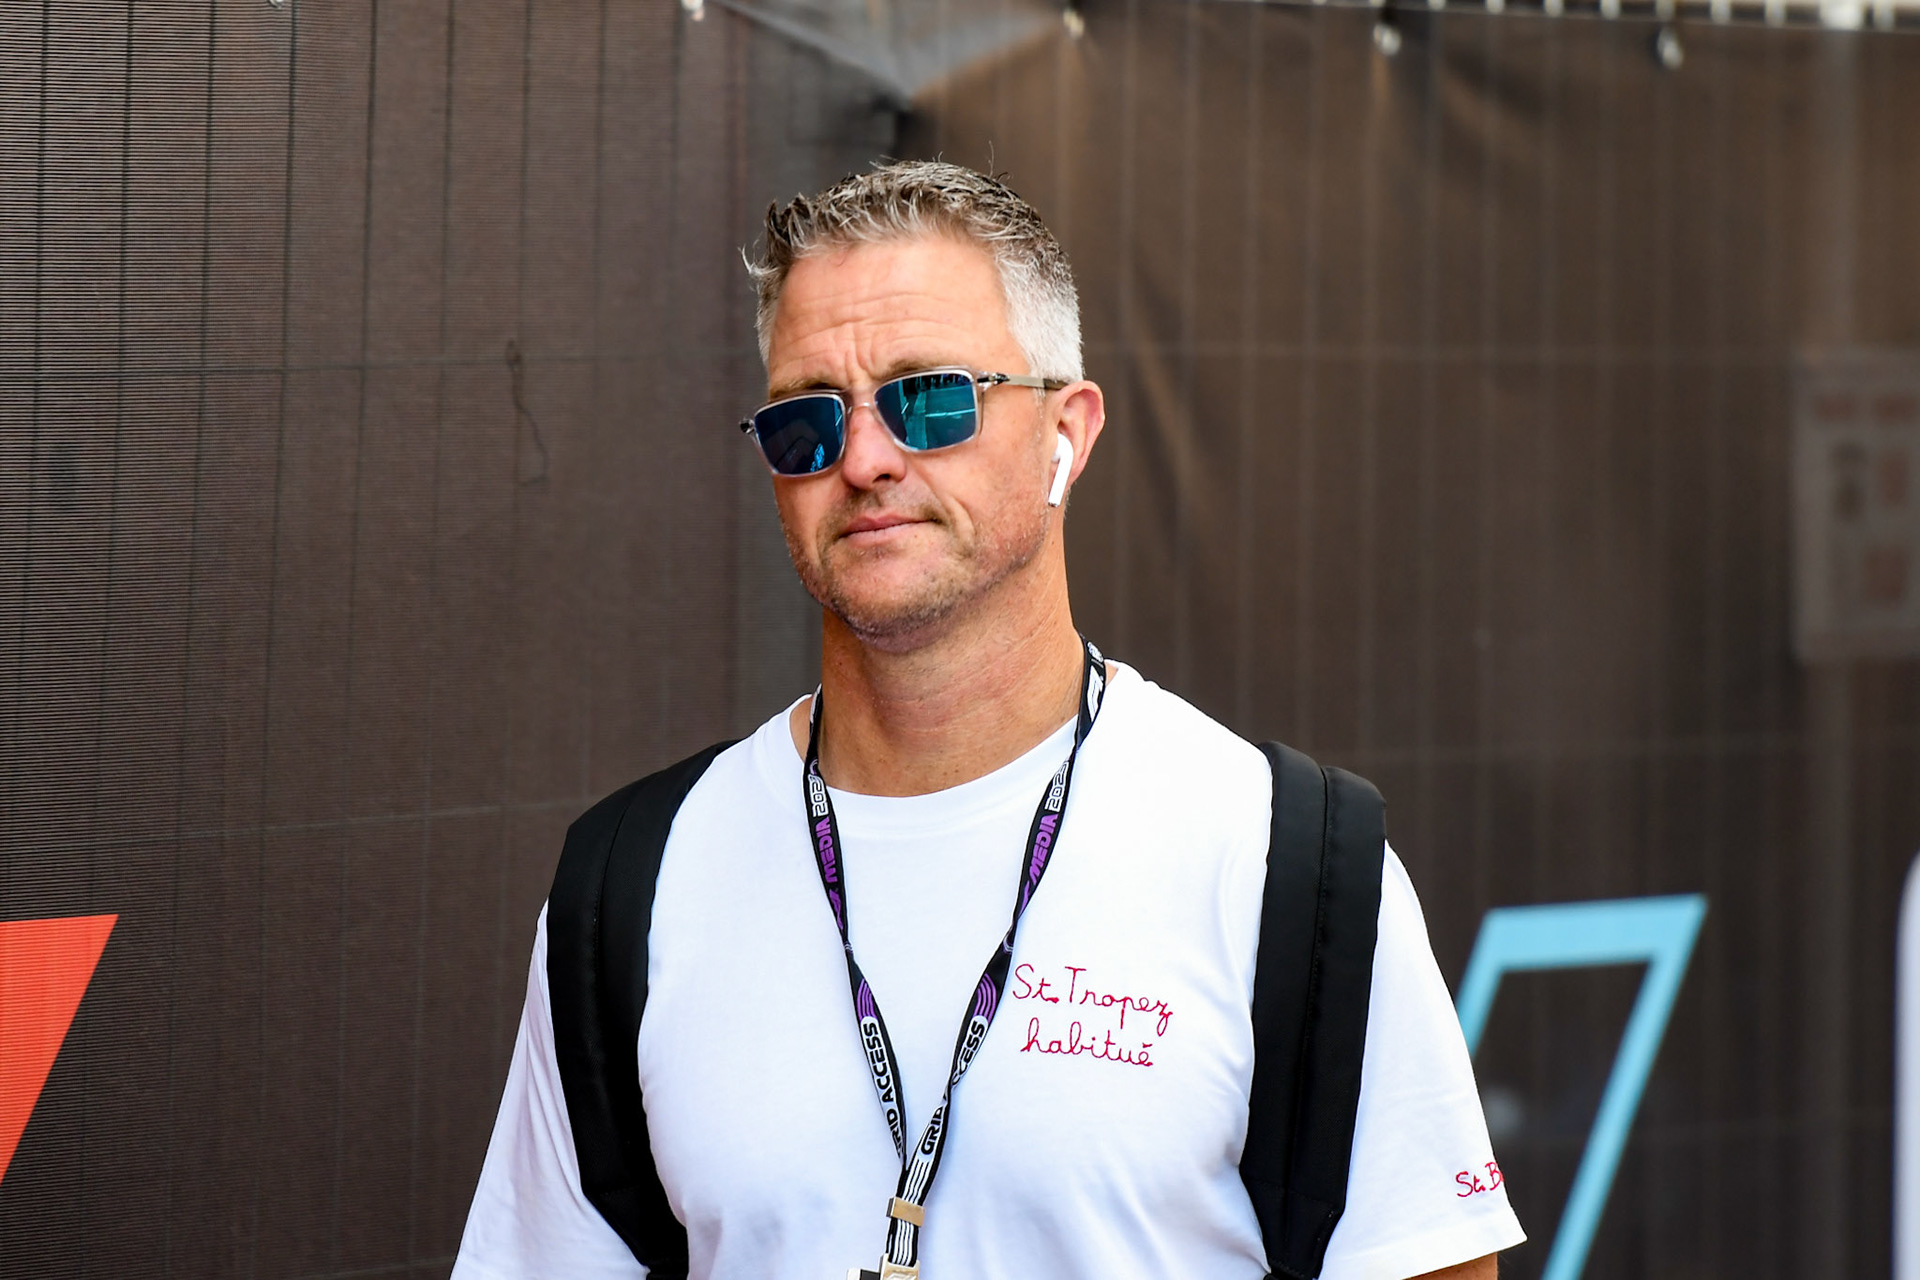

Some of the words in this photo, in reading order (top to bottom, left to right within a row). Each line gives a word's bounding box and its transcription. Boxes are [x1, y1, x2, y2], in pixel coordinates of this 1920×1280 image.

[815, 816, 839, 884] MEDIA
[1028, 813, 1059, 886] MEDIA
[1064, 966, 1174, 1037] Tropez
[863, 1021, 895, 1104] ACCESS
[920, 1105, 944, 1156] GRID
